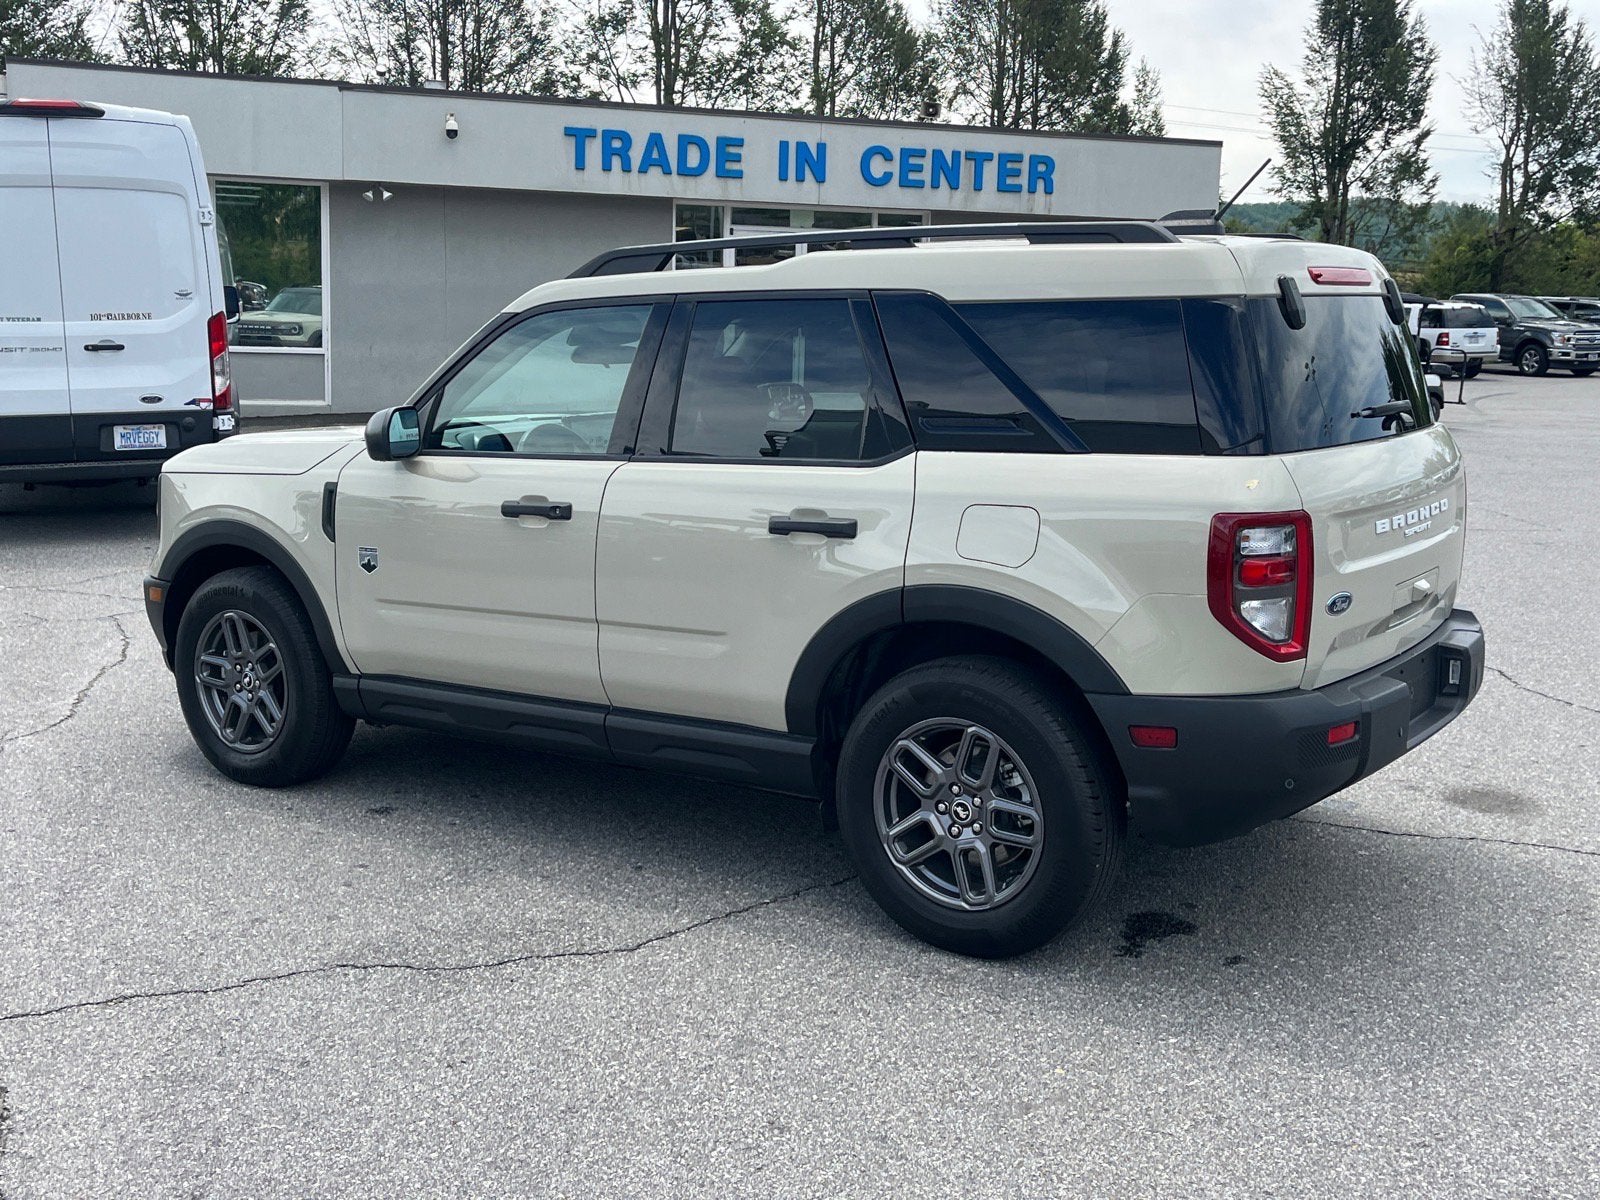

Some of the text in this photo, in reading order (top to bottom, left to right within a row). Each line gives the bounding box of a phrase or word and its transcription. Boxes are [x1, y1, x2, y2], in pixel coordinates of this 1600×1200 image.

[563, 126, 1057, 196] TRADE IN CENTER
[112, 312, 153, 321] AIRBORNE
[120, 431, 160, 444] MRVEGGY
[1375, 499, 1449, 534] BRONCO
[1404, 520, 1432, 537] SPORT
